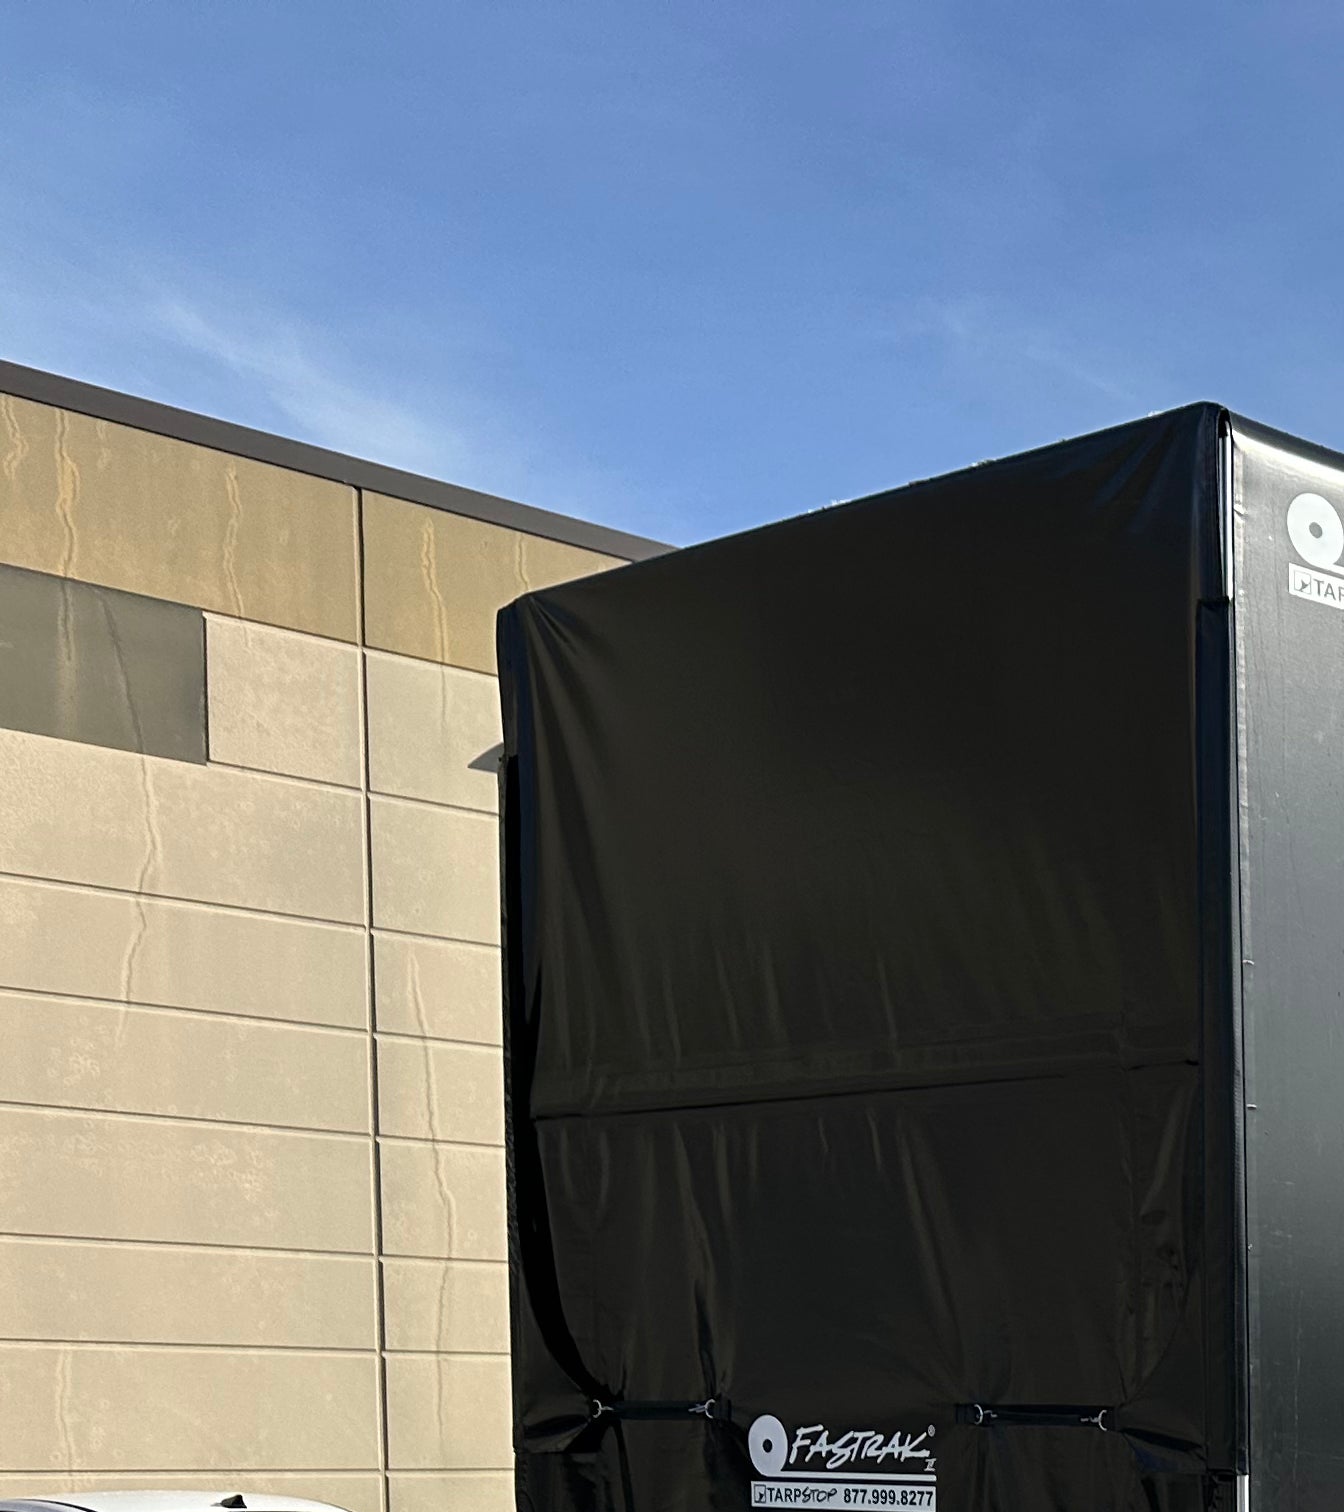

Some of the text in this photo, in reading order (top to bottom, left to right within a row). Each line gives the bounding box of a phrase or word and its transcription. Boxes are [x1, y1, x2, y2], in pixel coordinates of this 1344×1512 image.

[788, 1424, 931, 1470] FASTRAK
[766, 1486, 934, 1507] TARPSTOP 877.999.8277
